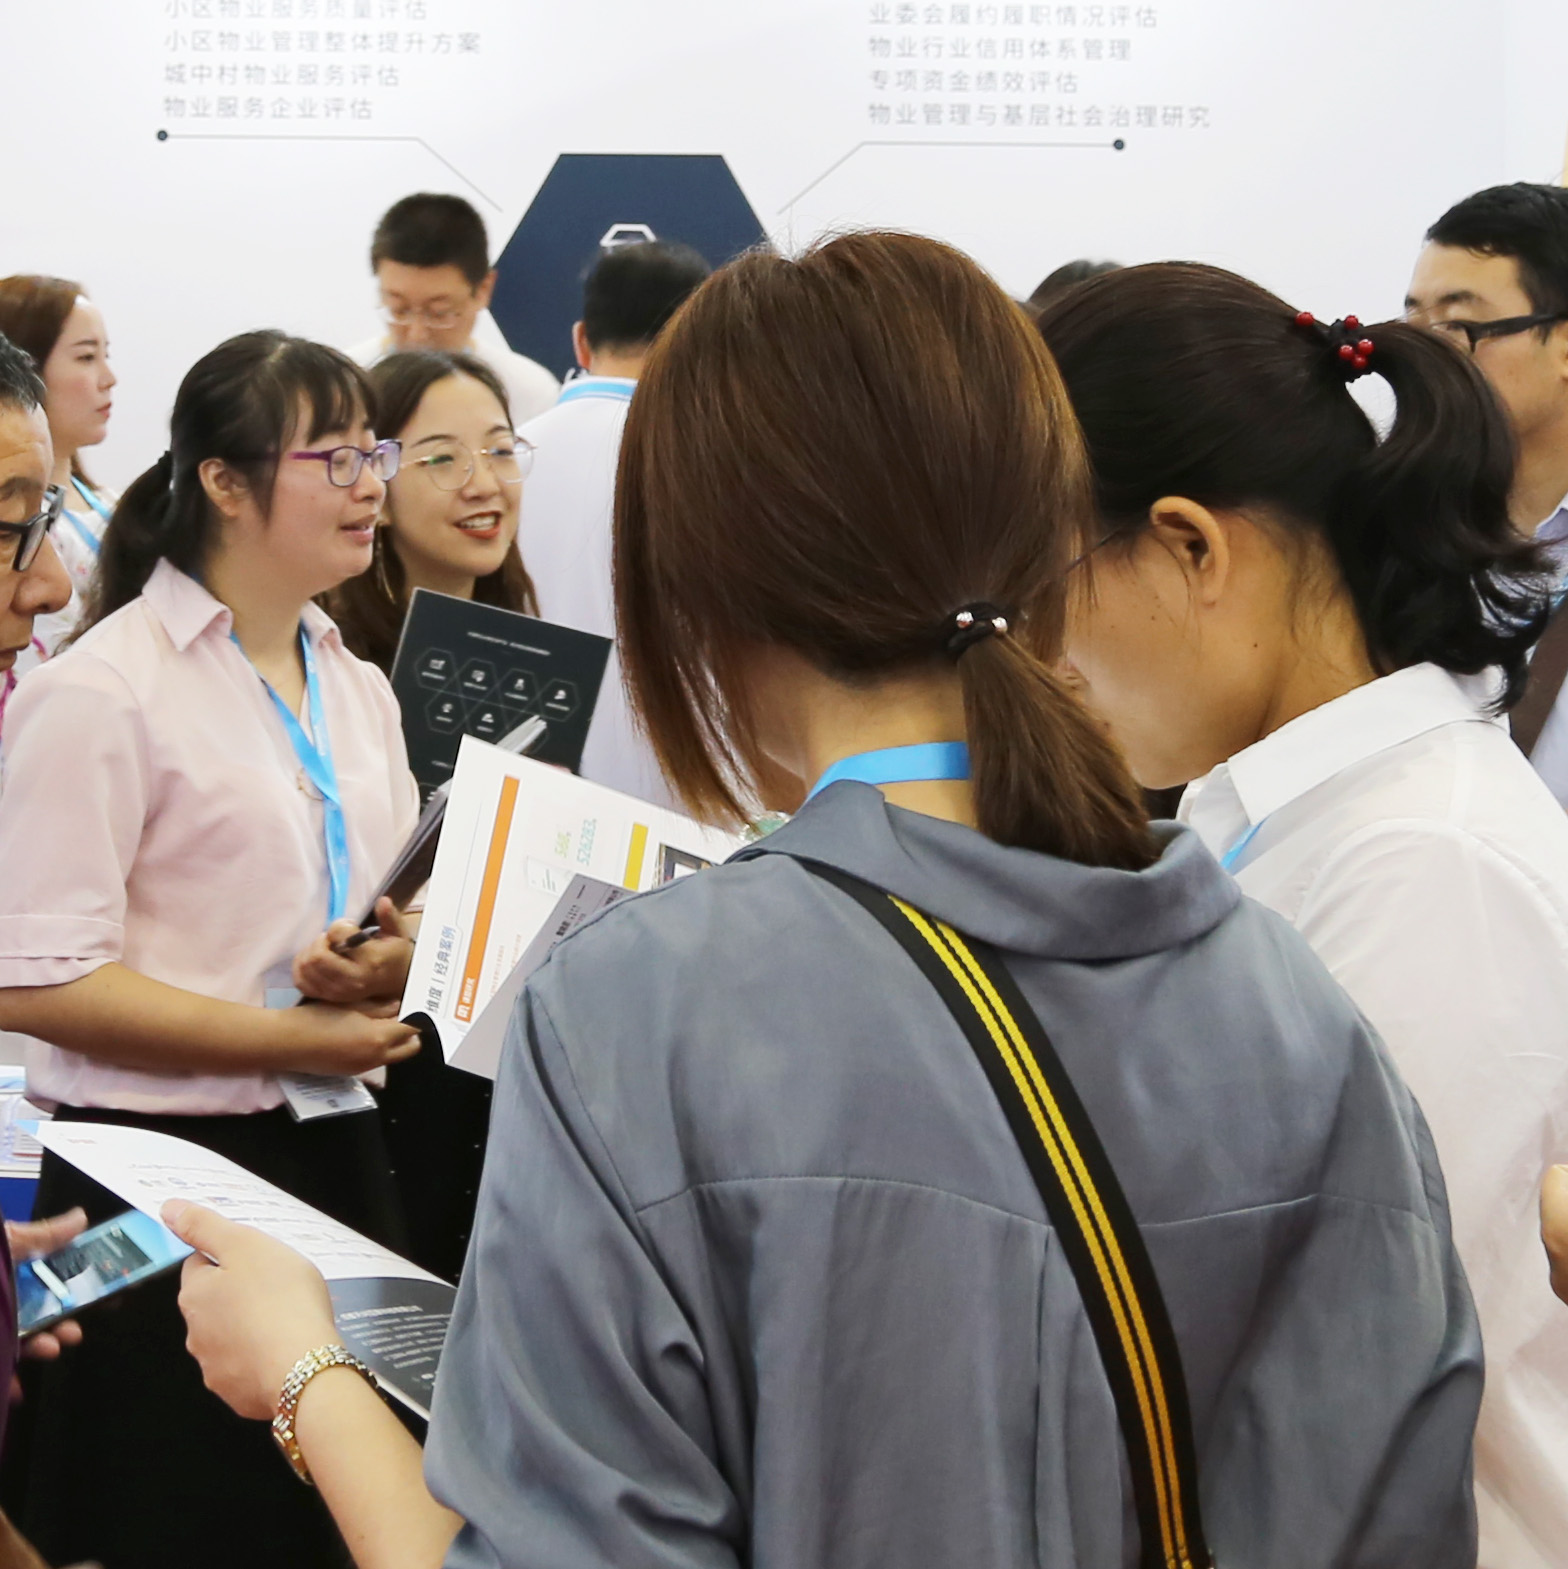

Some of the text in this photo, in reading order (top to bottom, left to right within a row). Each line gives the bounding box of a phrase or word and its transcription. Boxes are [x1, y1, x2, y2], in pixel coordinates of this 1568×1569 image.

[868, 3, 1159, 29] 业委会履约履职情况评估
[164, 30, 481, 54] 小区物业管理整体提升方案
[868, 37, 1132, 62] 物业行业信用体系管理
[163, 63, 401, 88] 城中村物业服务评估
[868, 70, 1079, 94] 专项资金绩效评估
[163, 96, 374, 121] 物业服务企业评估
[868, 103, 1212, 130] 物业管理与基层社会治理研究
[425, 925, 457, 1014] 维度 经典案例
